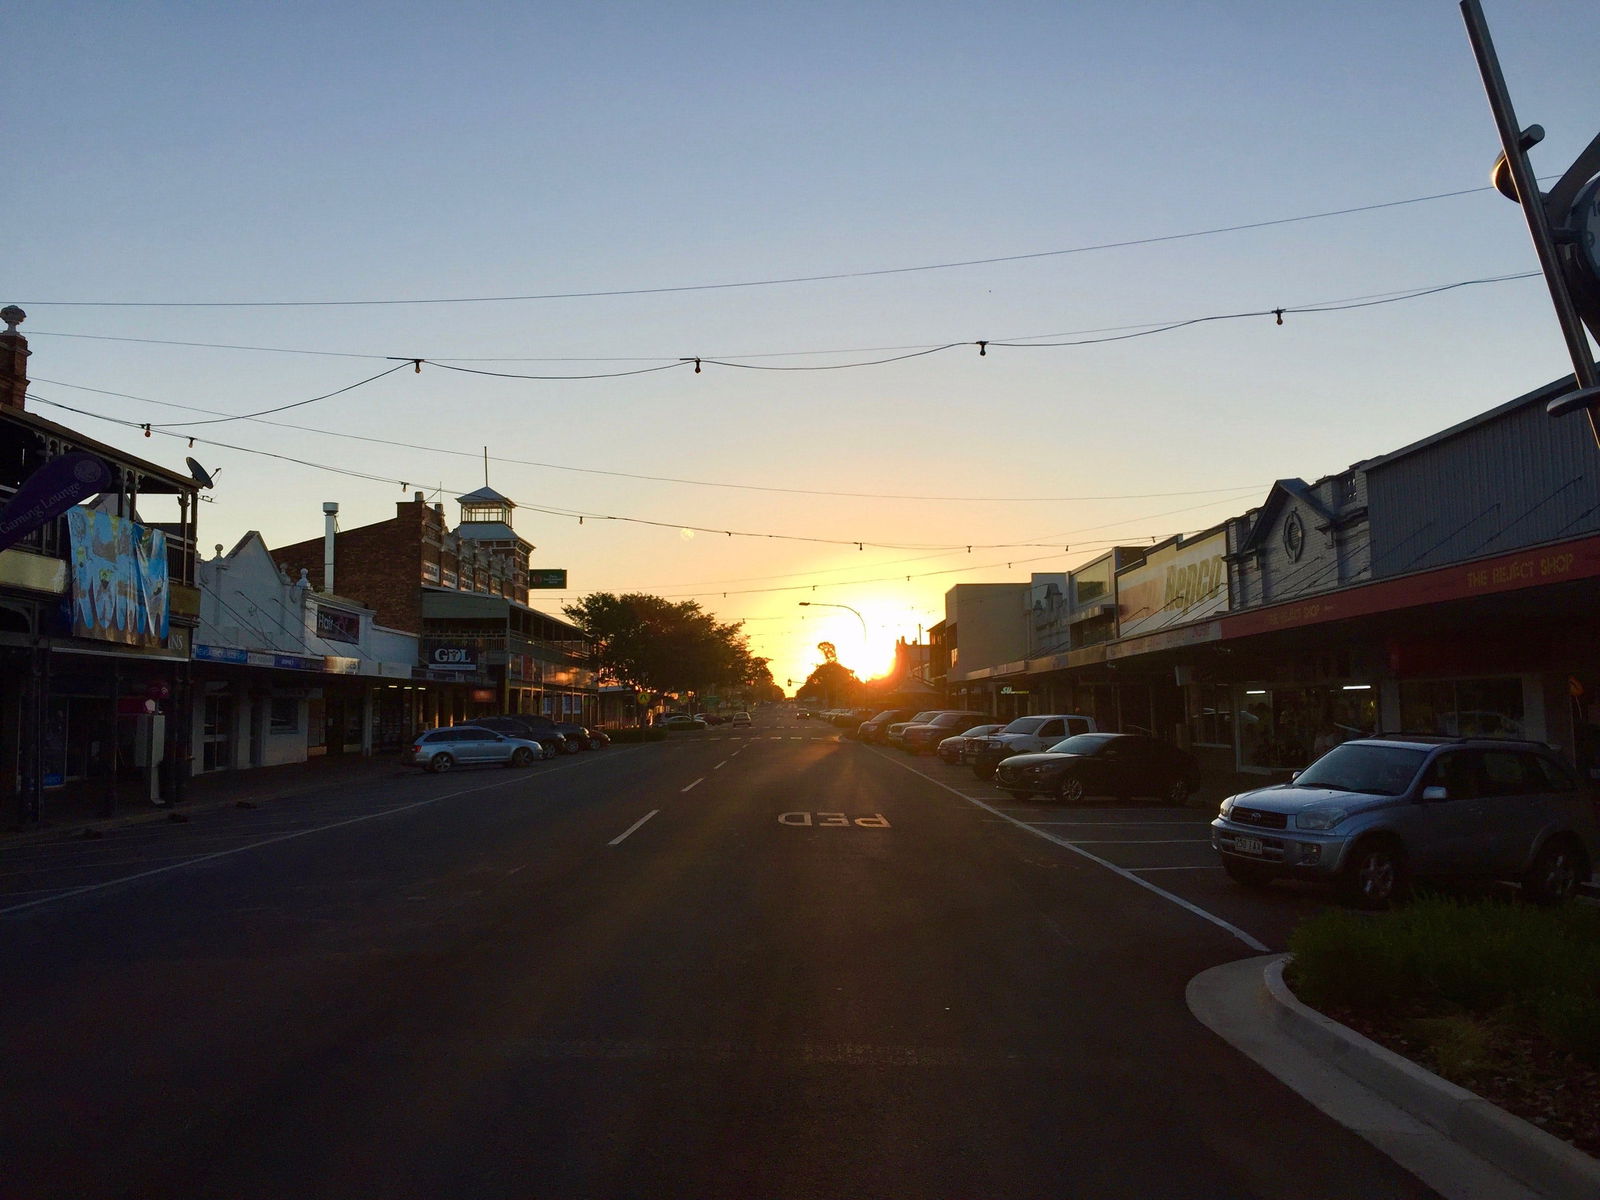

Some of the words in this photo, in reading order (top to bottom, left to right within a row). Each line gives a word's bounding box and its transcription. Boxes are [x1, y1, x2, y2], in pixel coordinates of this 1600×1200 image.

[40, 482, 81, 509] Lounge
[1466, 569, 1488, 588] THE
[1492, 560, 1535, 585] REJECT
[1540, 552, 1575, 576] SHOP
[318, 613, 334, 630] Hair
[434, 648, 471, 663] GDL
[778, 811, 892, 829] PED
